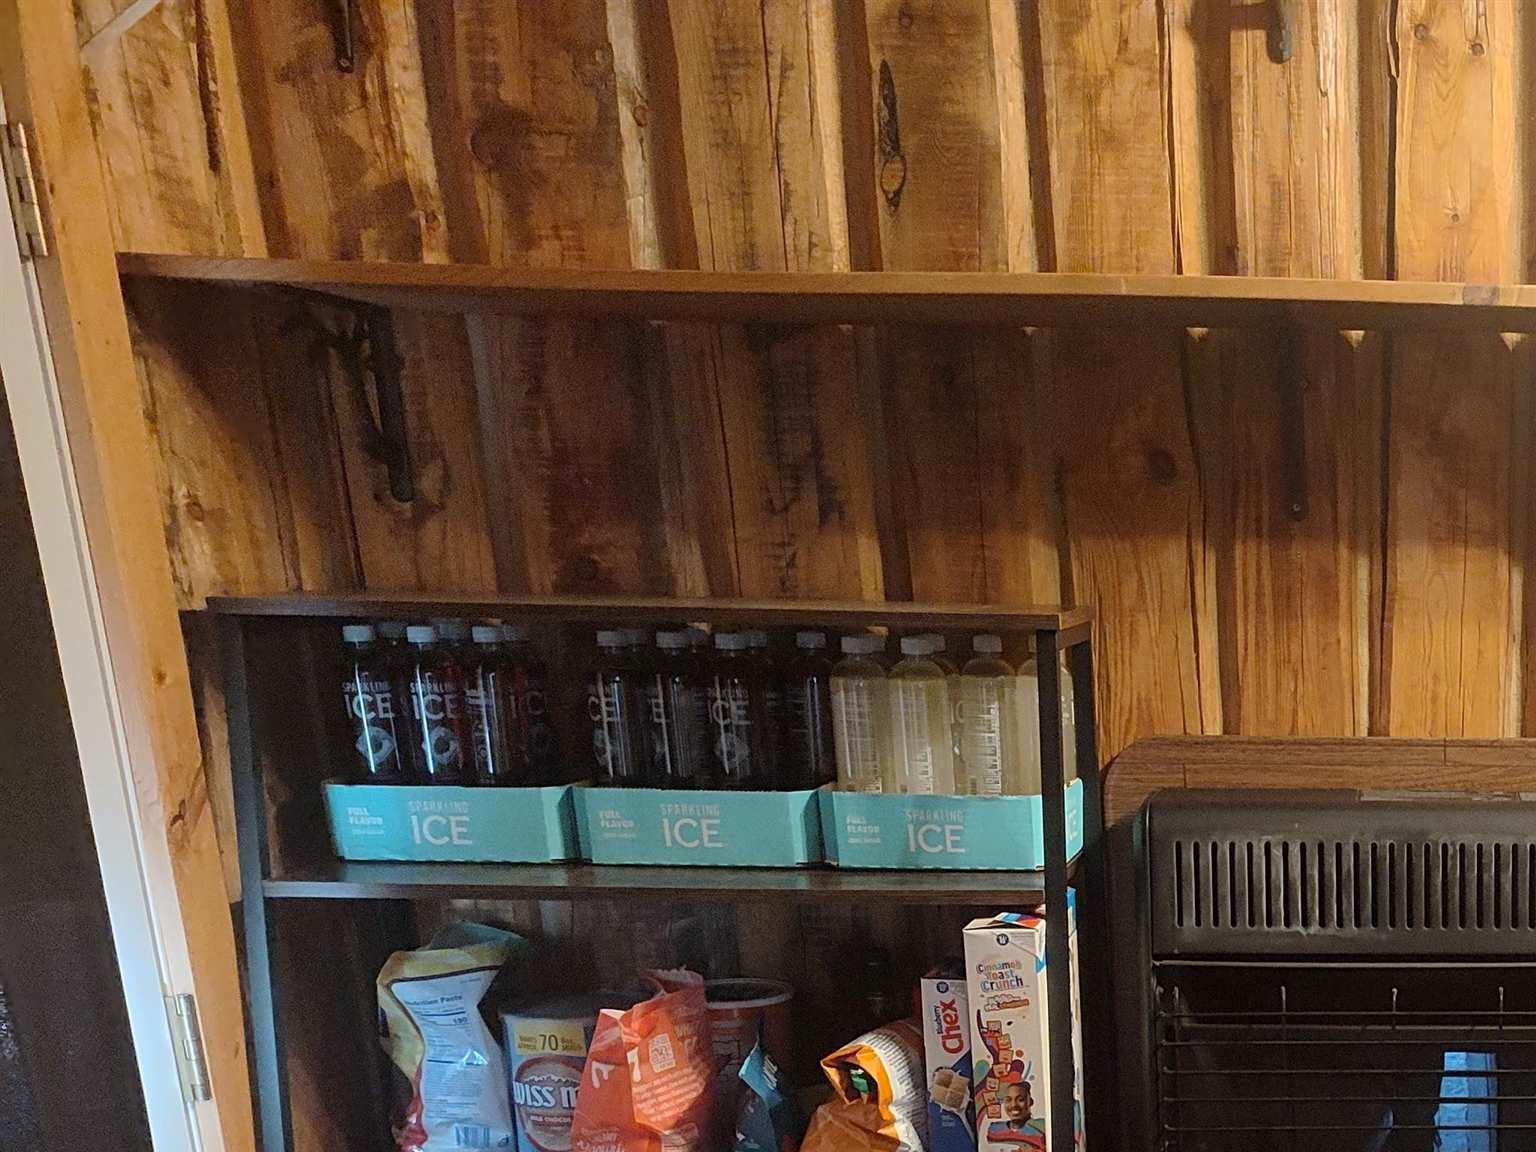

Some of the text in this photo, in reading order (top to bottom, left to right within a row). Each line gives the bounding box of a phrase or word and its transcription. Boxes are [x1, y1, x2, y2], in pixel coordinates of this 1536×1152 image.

[411, 815, 473, 845] ICE
[662, 818, 724, 848] ICE
[907, 824, 966, 853] ICE
[976, 960, 1023, 974] Cinnamon
[980, 975, 1024, 993] Crunch
[940, 998, 964, 1055] Chex
[539, 1034, 559, 1051] 70
